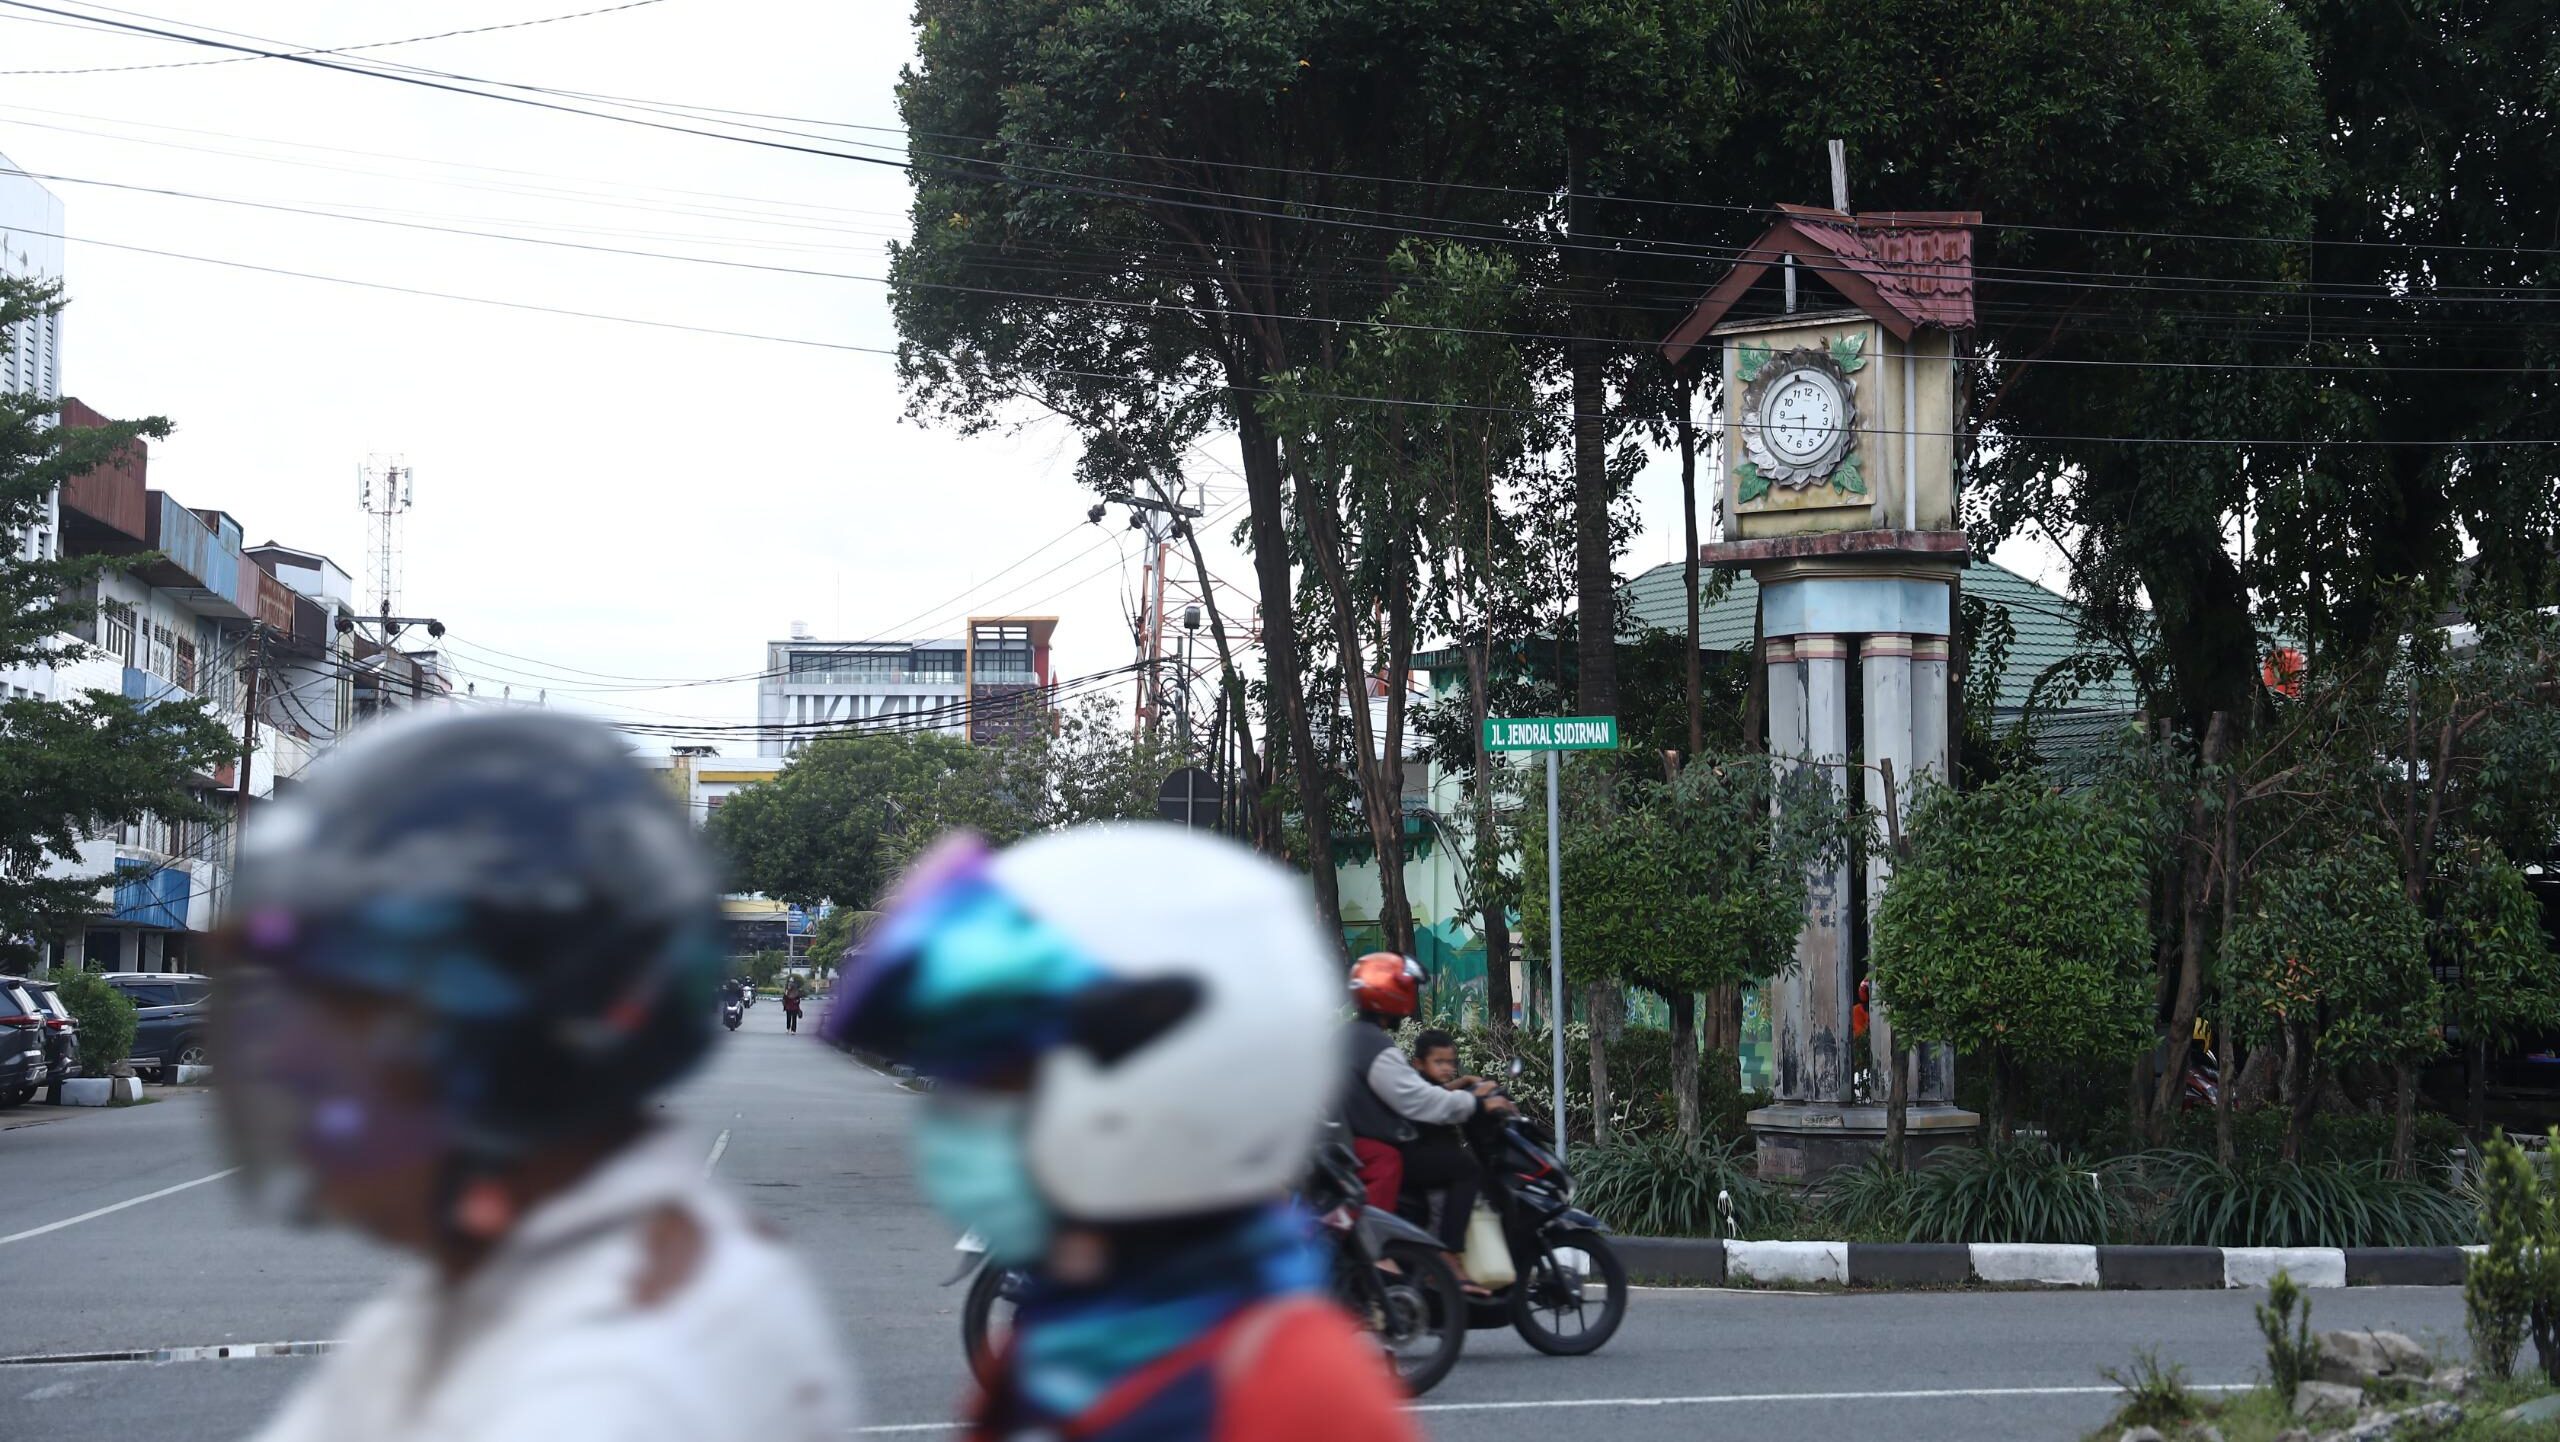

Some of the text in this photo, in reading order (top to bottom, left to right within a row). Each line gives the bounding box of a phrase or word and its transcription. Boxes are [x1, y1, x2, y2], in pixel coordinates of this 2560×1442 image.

[1793, 390, 1801, 398] 11
[1804, 388, 1813, 397] 12
[1784, 398, 1793, 407] 10
[1822, 403, 1828, 411] 2
[1780, 411, 1785, 419] 9
[1823, 417, 1828, 425] 3
[1780, 424, 1786, 432] 8
[1817, 429, 1823, 438] 4
[1787, 435, 1792, 443] 7
[1796, 440, 1802, 448] 6
[1491, 722, 1609, 745] JL. JENDRAL SUDIRMAN
